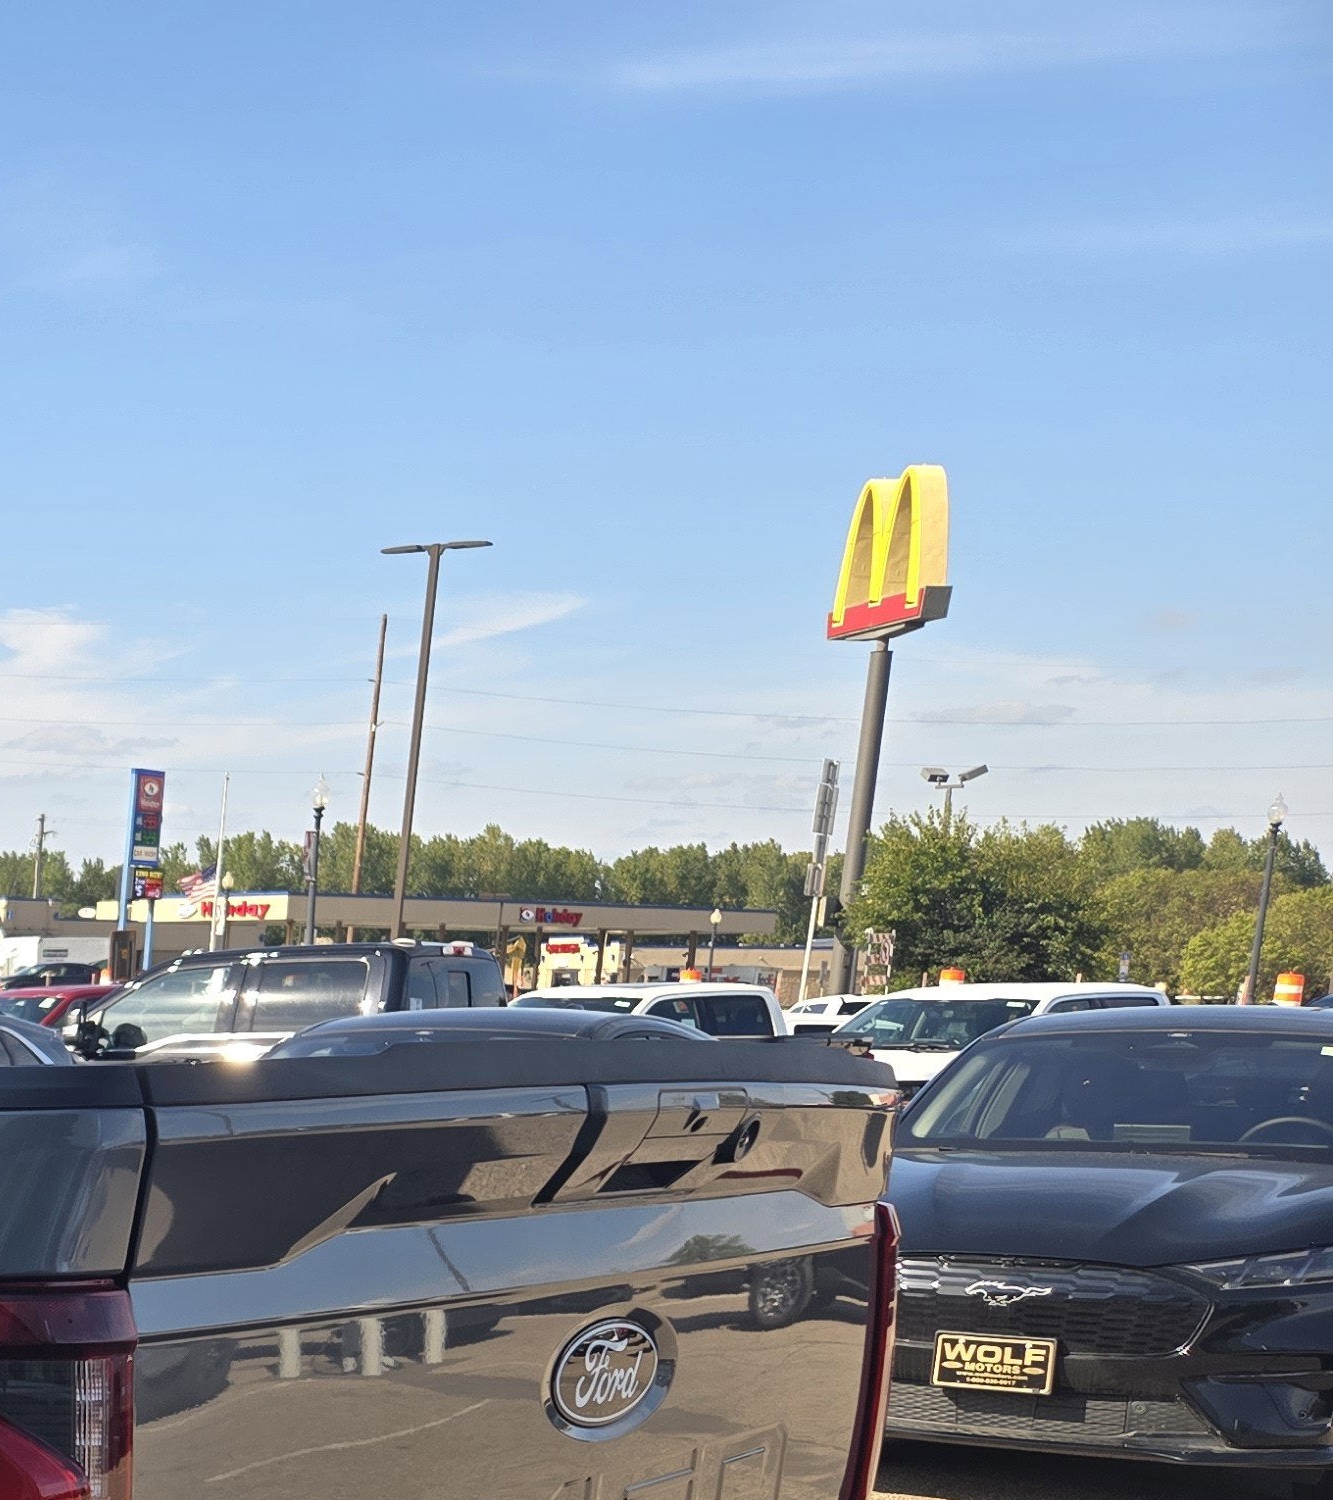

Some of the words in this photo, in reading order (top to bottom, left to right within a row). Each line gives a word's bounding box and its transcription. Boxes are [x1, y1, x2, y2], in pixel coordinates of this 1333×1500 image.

[536, 908, 583, 927] Holiday
[944, 1342, 1047, 1366] WOLF
[575, 1336, 643, 1408] Ford
[964, 1361, 1021, 1375] MOTORS
